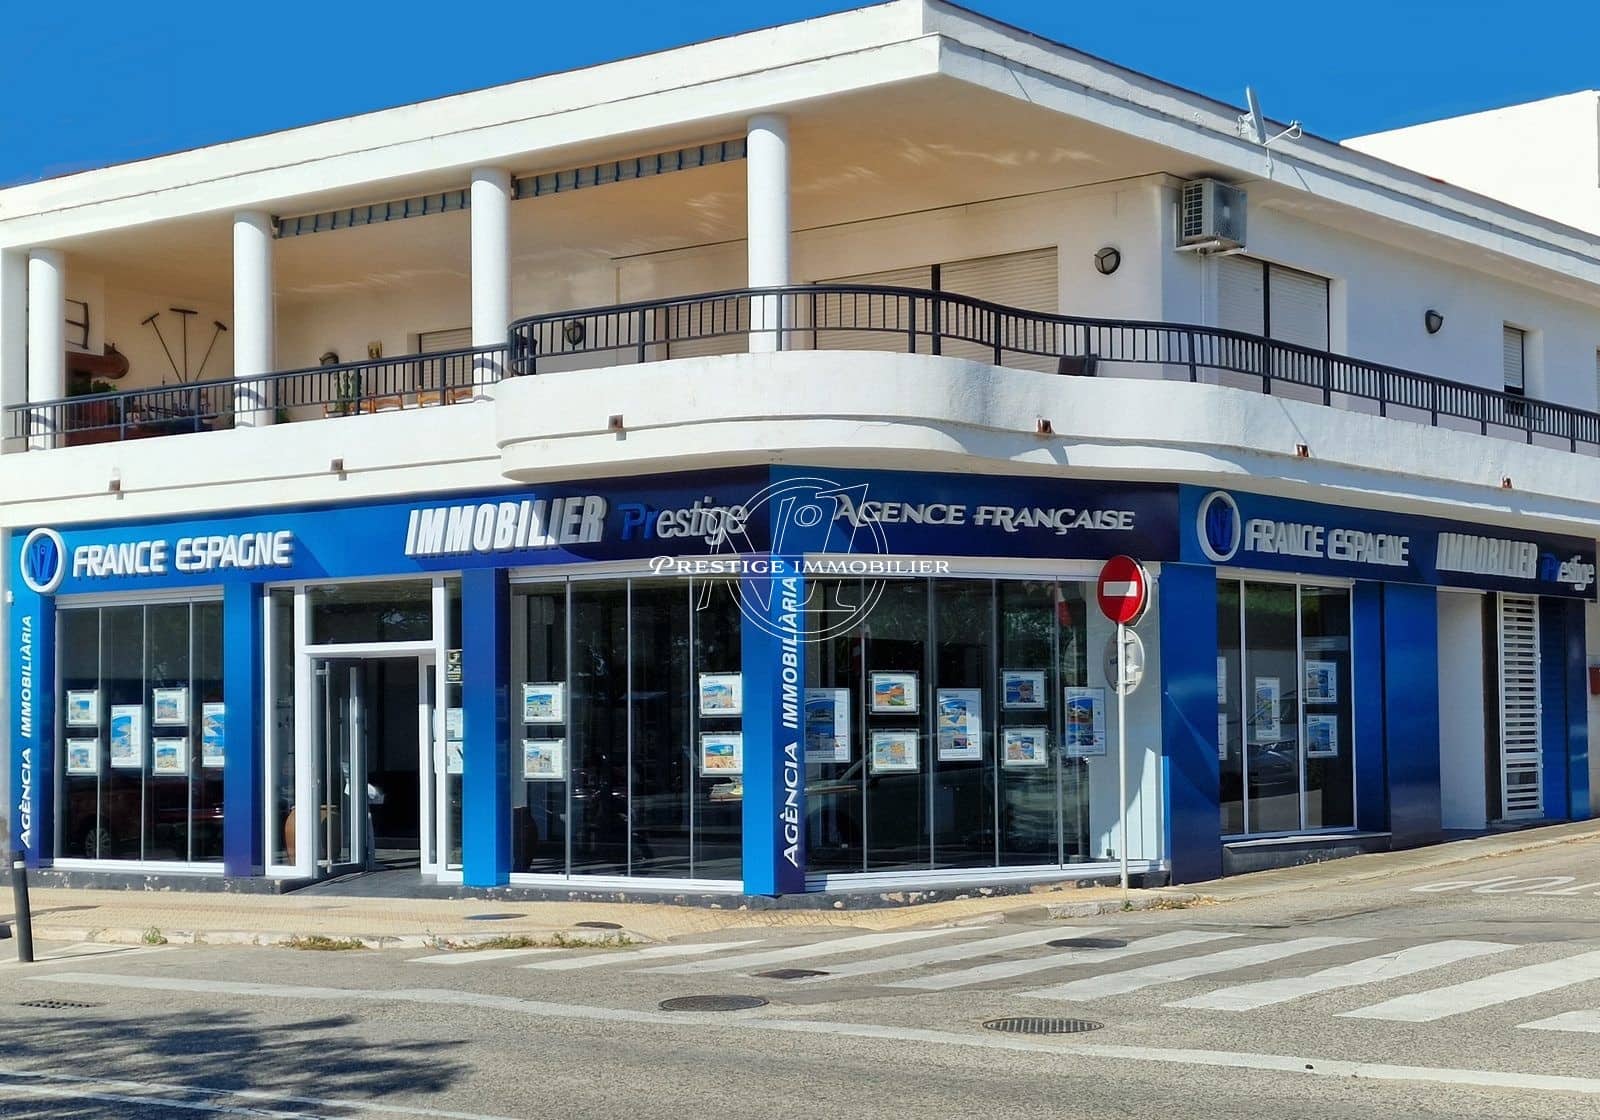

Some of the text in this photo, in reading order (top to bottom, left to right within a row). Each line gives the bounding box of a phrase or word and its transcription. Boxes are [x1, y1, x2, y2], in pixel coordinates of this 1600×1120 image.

[72, 530, 294, 578] FRANCE ESPAGNE
[404, 496, 749, 556] IMMOBILIER Prestige
[1245, 518, 1410, 567] FRANCE ESPAGNE
[1435, 532, 1595, 592] IMMOBILIER Prestige
[19, 615, 33, 849] AGÈNCIA IMMOBILIÀRIA
[778, 576, 800, 868] AGÈNCIA IMMOBILIÀRIA
[1409, 875, 1600, 896] TOP
